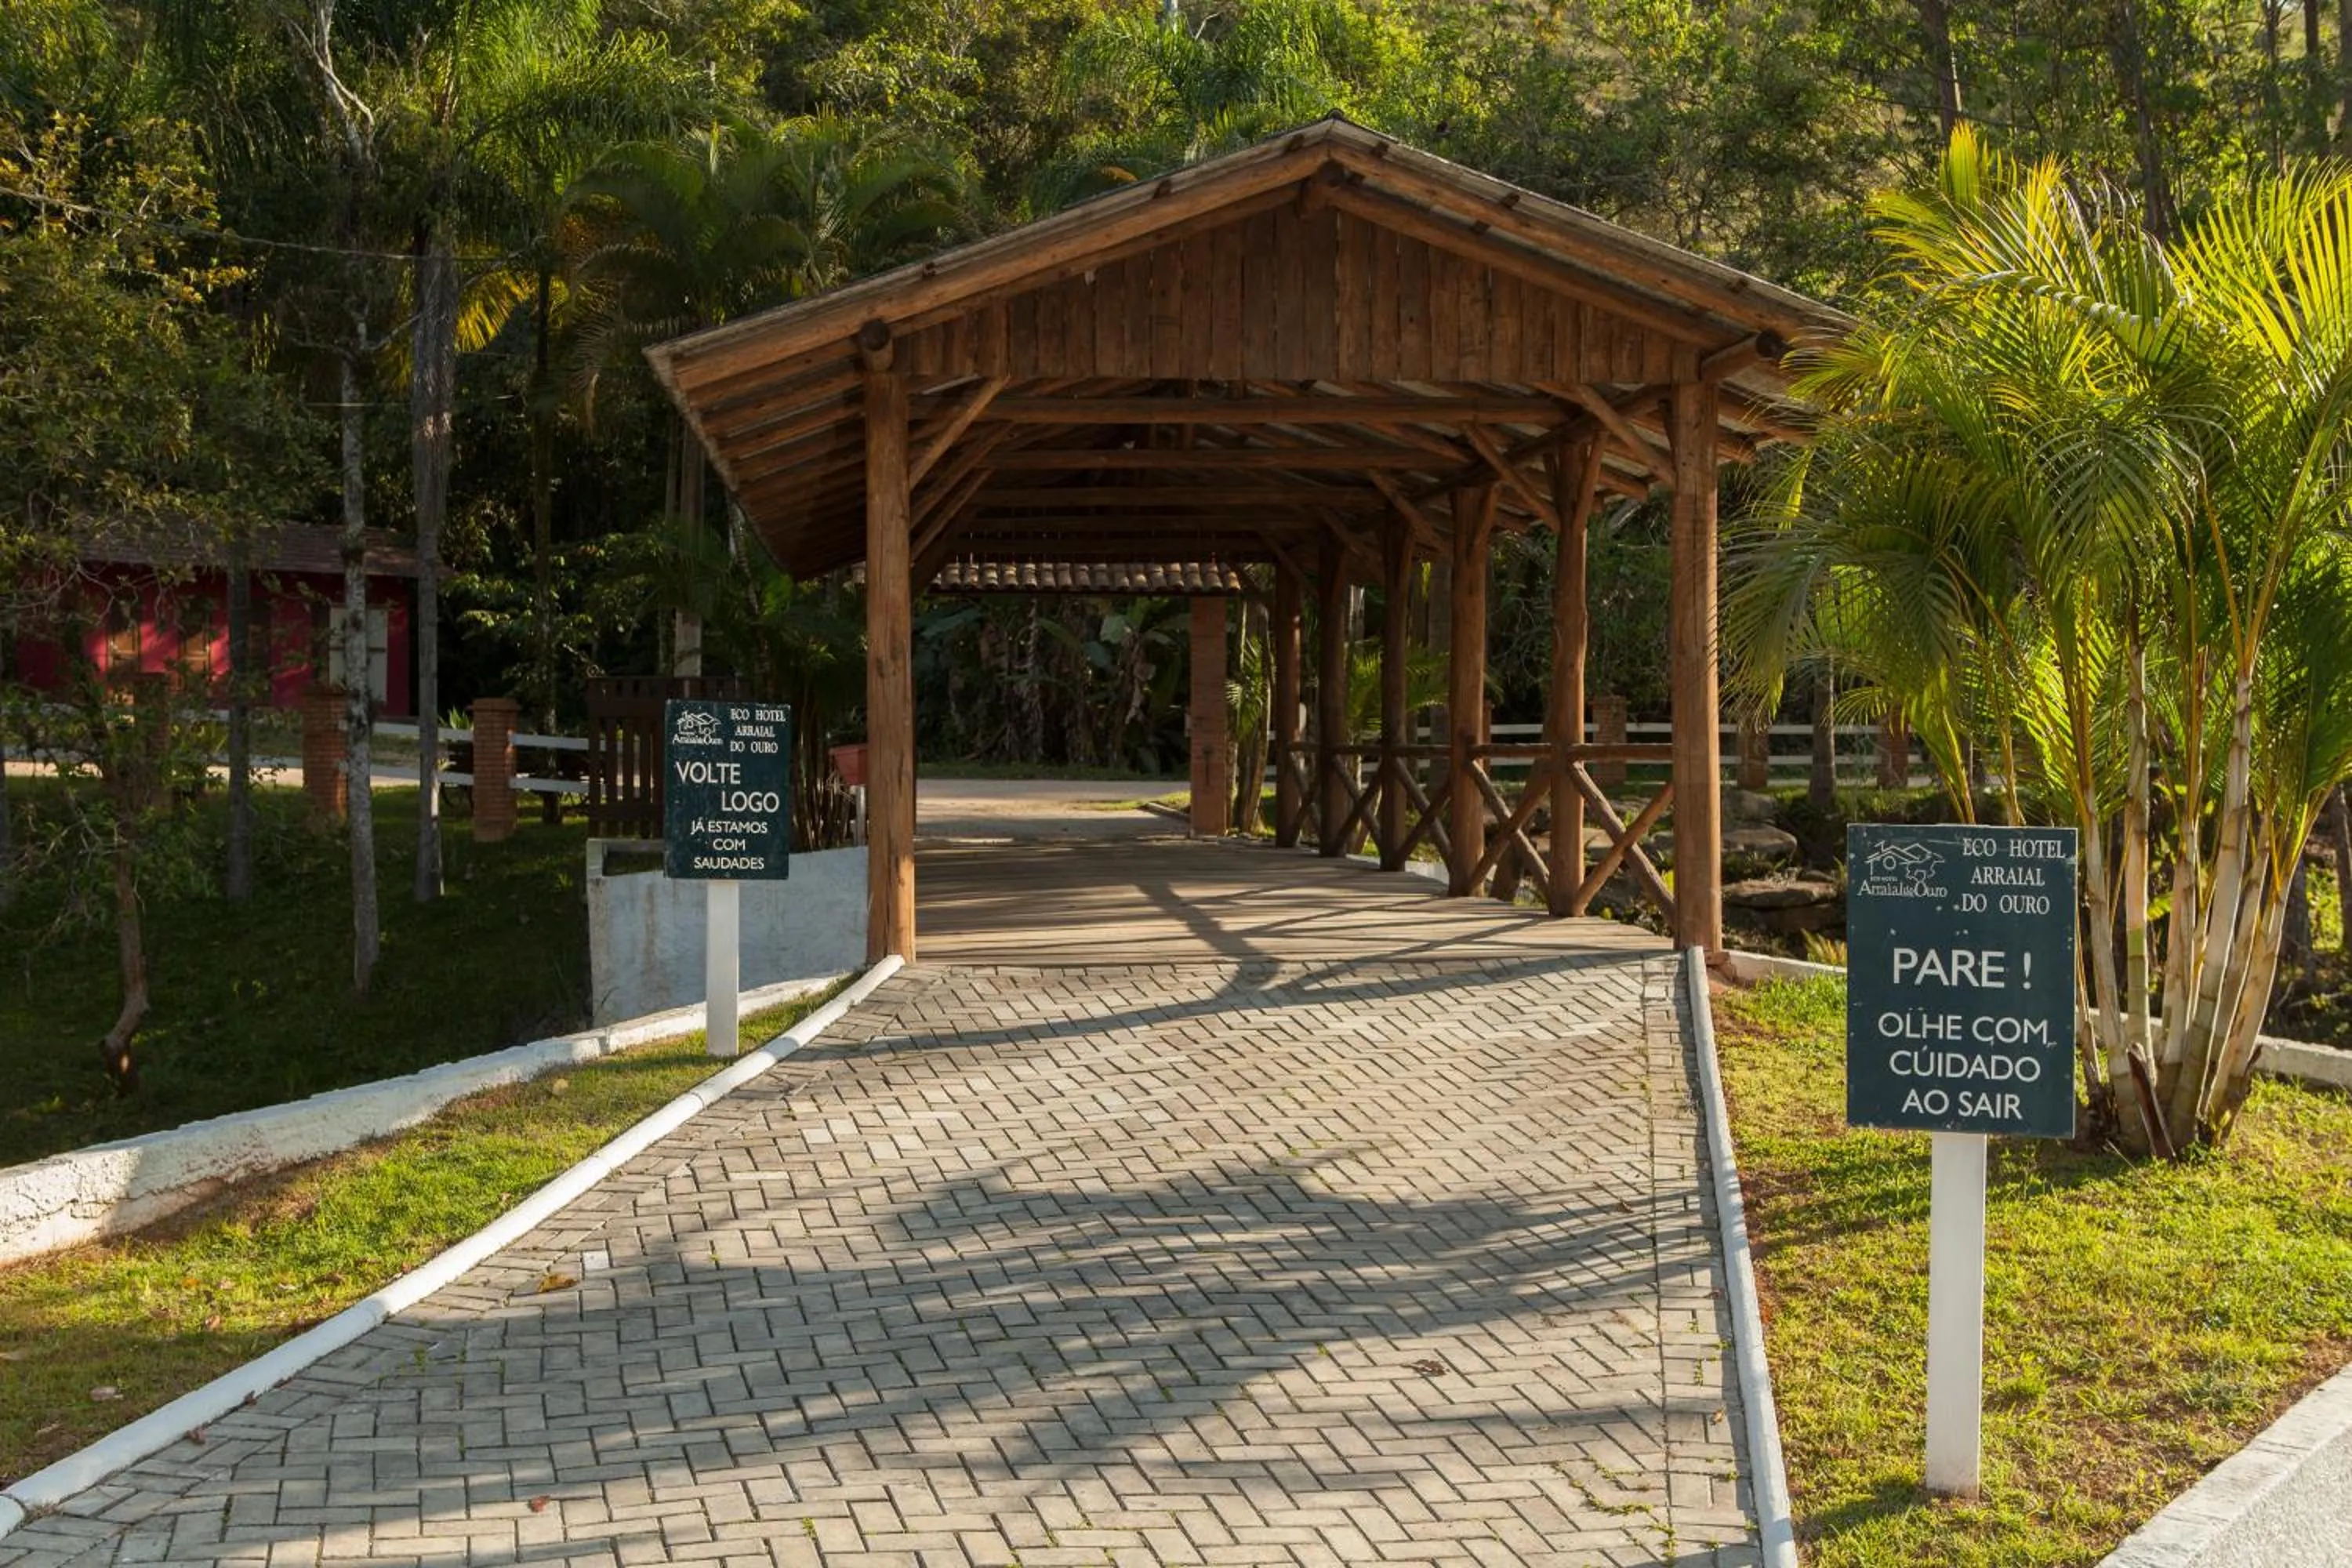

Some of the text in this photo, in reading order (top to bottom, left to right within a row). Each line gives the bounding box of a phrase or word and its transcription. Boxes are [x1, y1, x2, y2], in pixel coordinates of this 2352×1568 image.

[730, 708, 786, 722] ECO HOTEL
[735, 725, 775, 738] ARRAIAL
[730, 741, 779, 753] DO OURO
[675, 761, 741, 784] VOLTE
[721, 790, 780, 812] LOGO
[690, 816, 768, 835] JÁ ESTAMOS
[713, 838, 746, 851] COM
[1962, 838, 2066, 858] ECO HOTEL
[694, 857, 764, 869] SAUDADES
[1970, 866, 2045, 887] ARRAIAL
[1962, 893, 2050, 915] DO OURO
[1893, 947, 2005, 989] PARE
[1878, 1012, 2049, 1045] OLHE COM
[1901, 1088, 2024, 1120] AO SAIR
